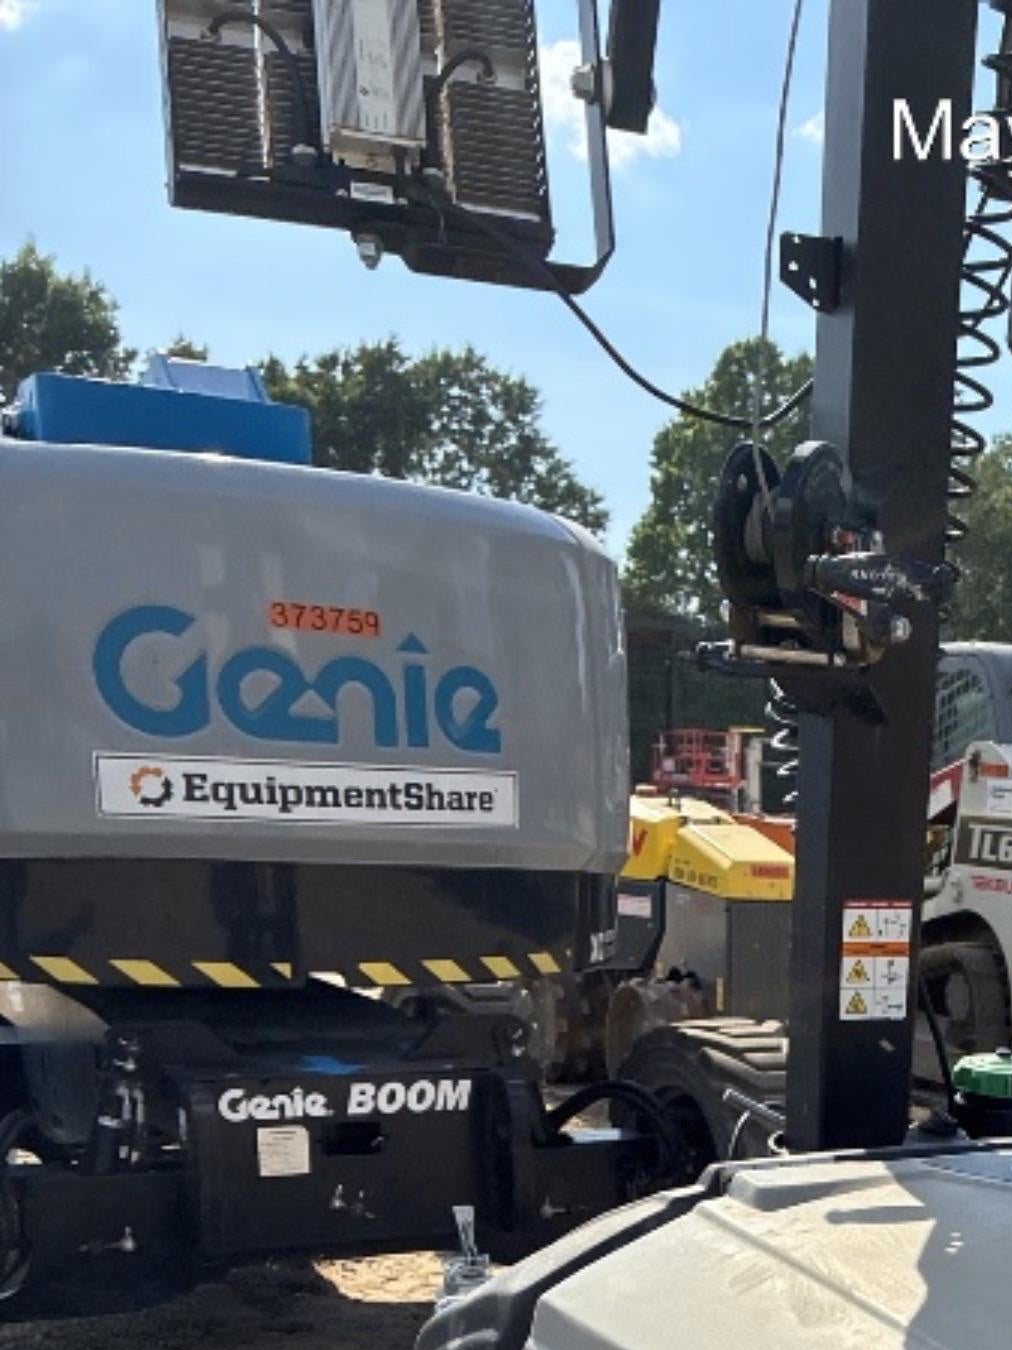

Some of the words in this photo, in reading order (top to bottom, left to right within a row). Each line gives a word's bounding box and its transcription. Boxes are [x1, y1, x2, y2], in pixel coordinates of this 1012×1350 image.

[270, 602, 380, 635] 373759
[93, 605, 501, 753] Genie
[183, 773, 494, 813] EquipmentShare
[218, 1086, 328, 1121] Genie
[347, 1079, 472, 1114] BOOM
